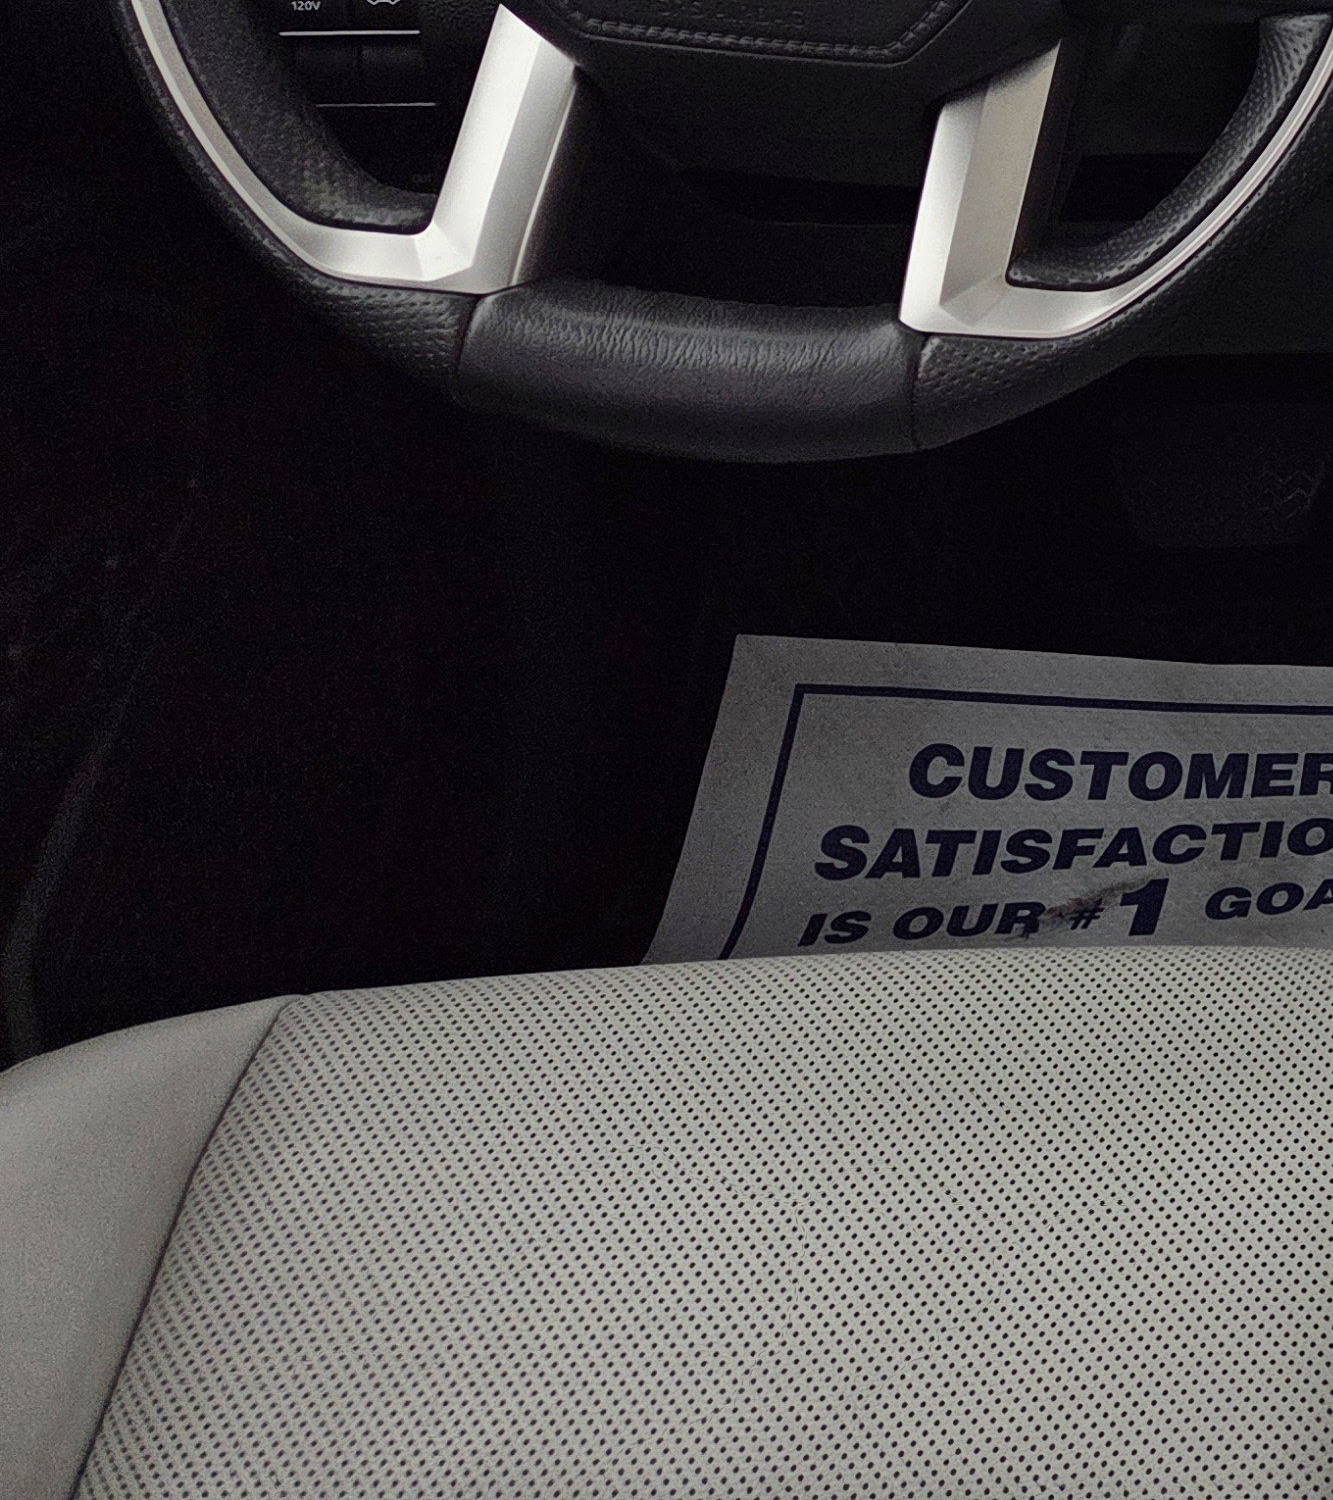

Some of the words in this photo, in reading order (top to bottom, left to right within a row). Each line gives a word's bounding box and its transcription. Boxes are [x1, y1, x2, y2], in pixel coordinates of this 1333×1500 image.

[291, 1, 322, 12] 120V
[797, 910, 869, 948] IS
[892, 900, 1049, 943] OUR
